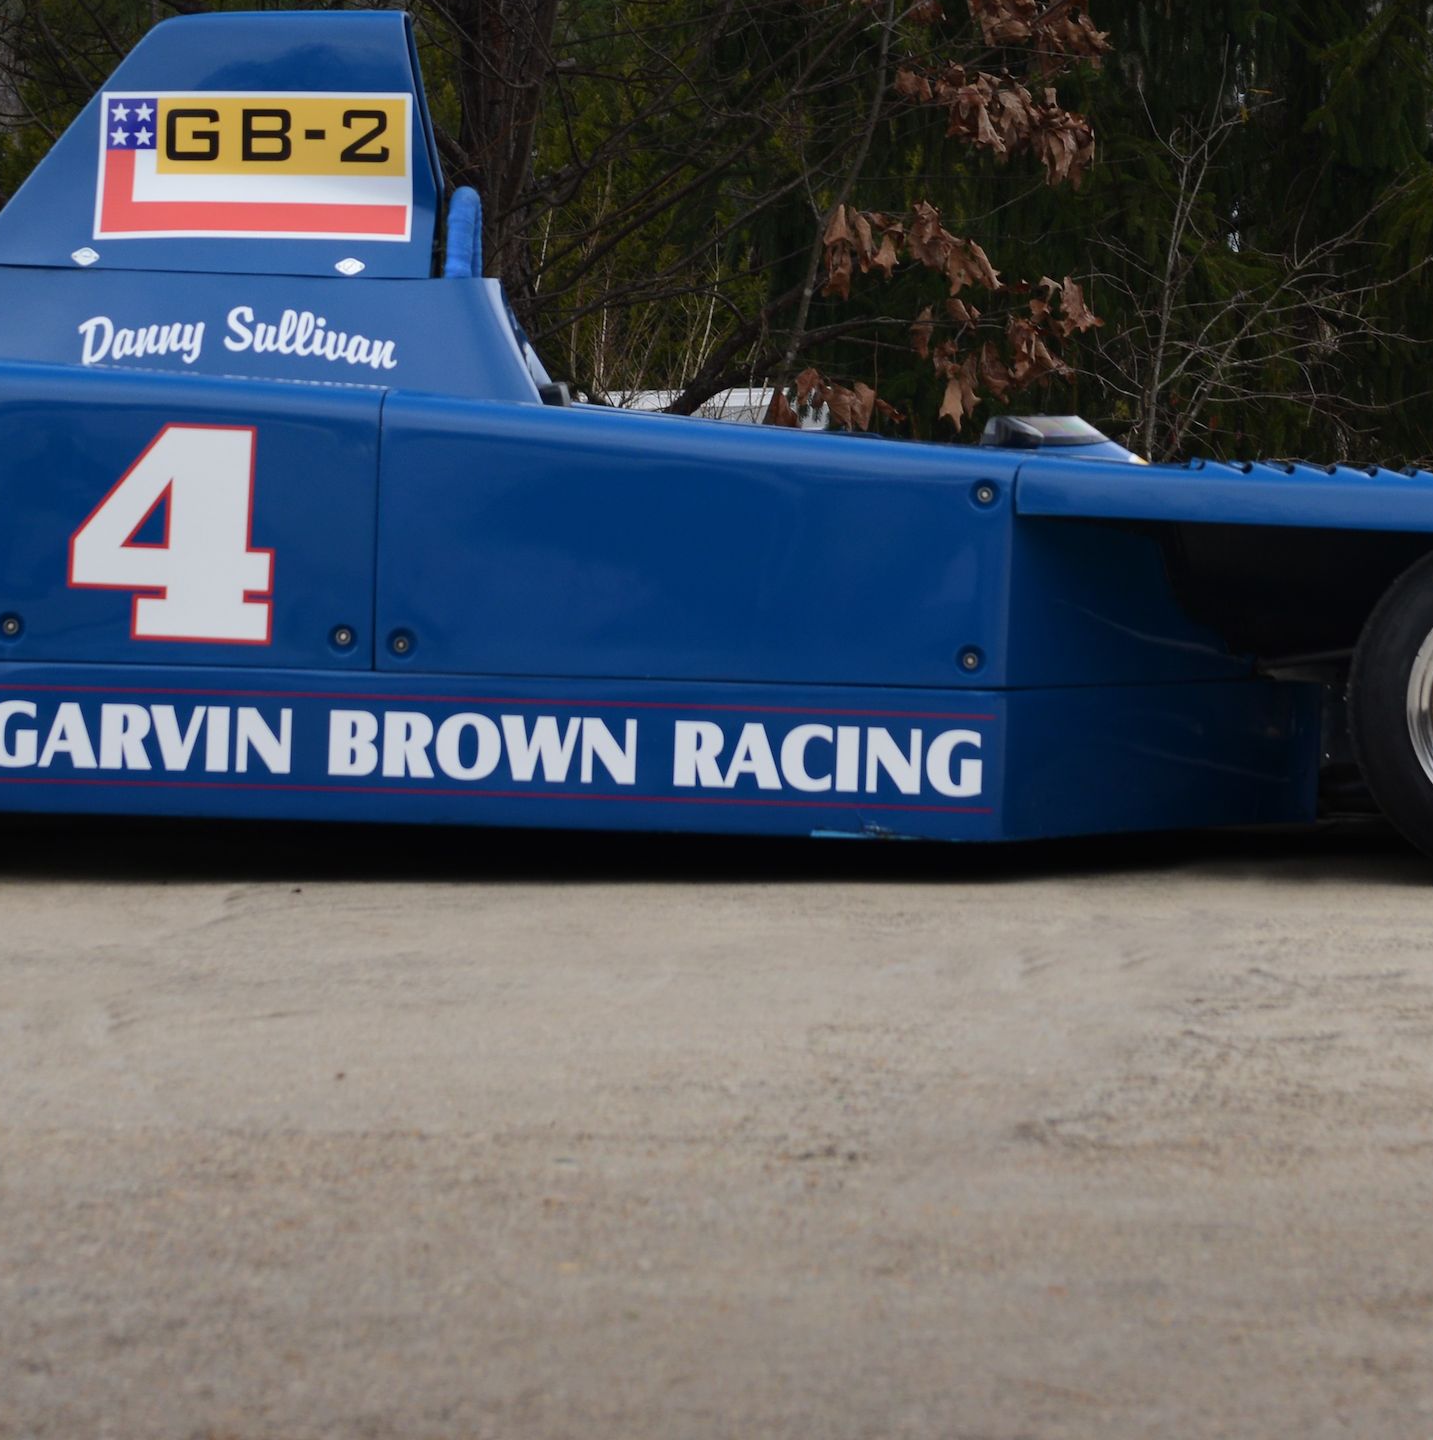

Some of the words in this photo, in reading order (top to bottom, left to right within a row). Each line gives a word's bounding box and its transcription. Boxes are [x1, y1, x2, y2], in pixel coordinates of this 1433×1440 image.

[164, 108, 390, 163] GB-2
[78, 315, 205, 366] Danny
[223, 306, 398, 370] Sullivan
[67, 422, 275, 646] 4
[327, 709, 637, 785] BROWN
[672, 720, 984, 798] RACING
